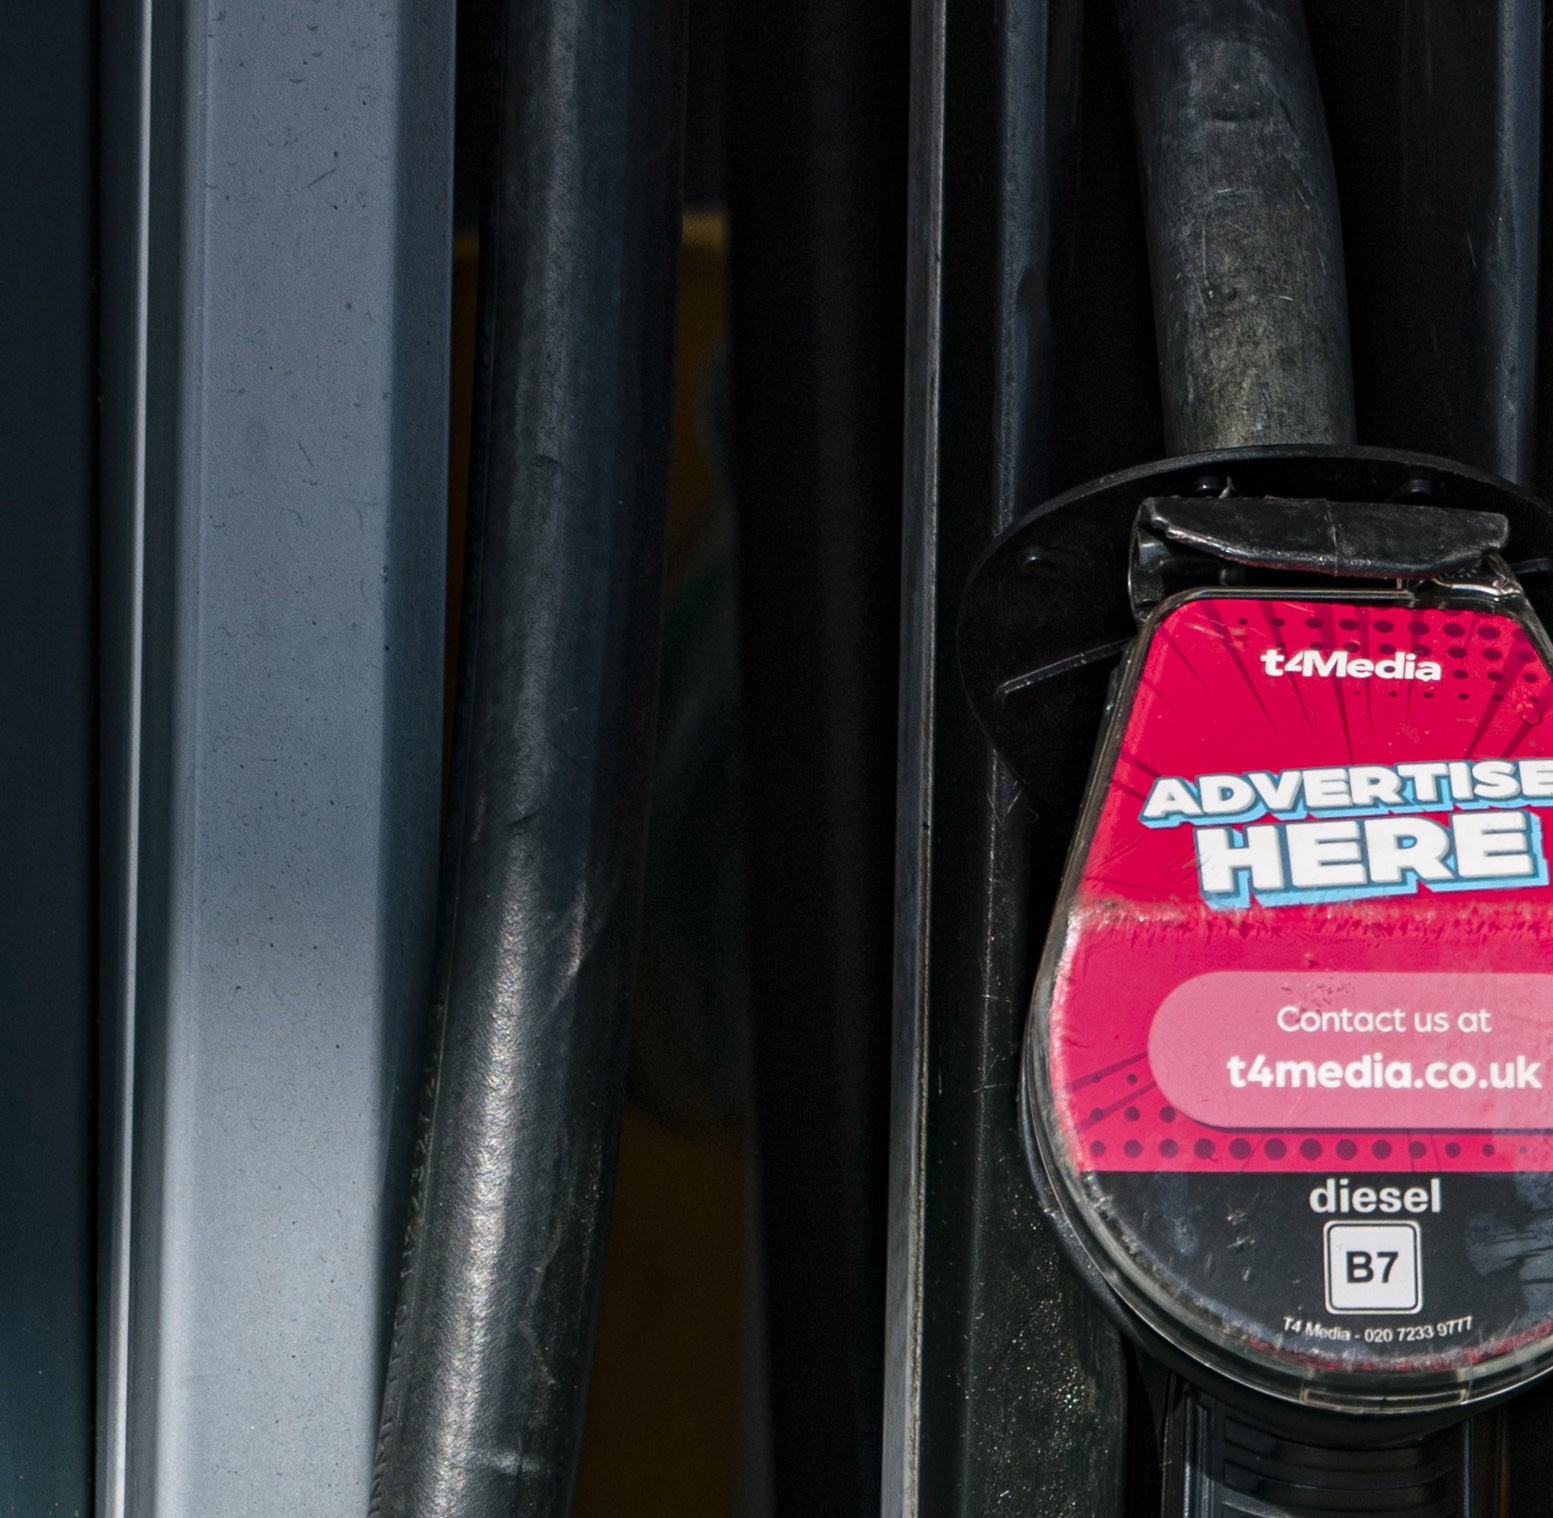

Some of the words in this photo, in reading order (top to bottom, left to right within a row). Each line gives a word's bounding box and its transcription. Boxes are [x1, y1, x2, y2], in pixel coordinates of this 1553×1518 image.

[1261, 649, 1442, 682] t4Media
[1196, 811, 1548, 909] HERE
[1277, 1006, 1406, 1033] Contact
[1413, 1011, 1450, 1033] us
[1457, 1007, 1492, 1033] at
[1227, 1053, 1542, 1090] t4media.co.uk
[1309, 1179, 1442, 1213] diesel
[1345, 1250, 1399, 1284] B7
[1283, 1316, 1301, 1333] T4
[1305, 1321, 1350, 1341] Media
[1364, 1328, 1393, 1342] 020
[1397, 1325, 1433, 1341] 7233
[1437, 1316, 1473, 1337] 9777
